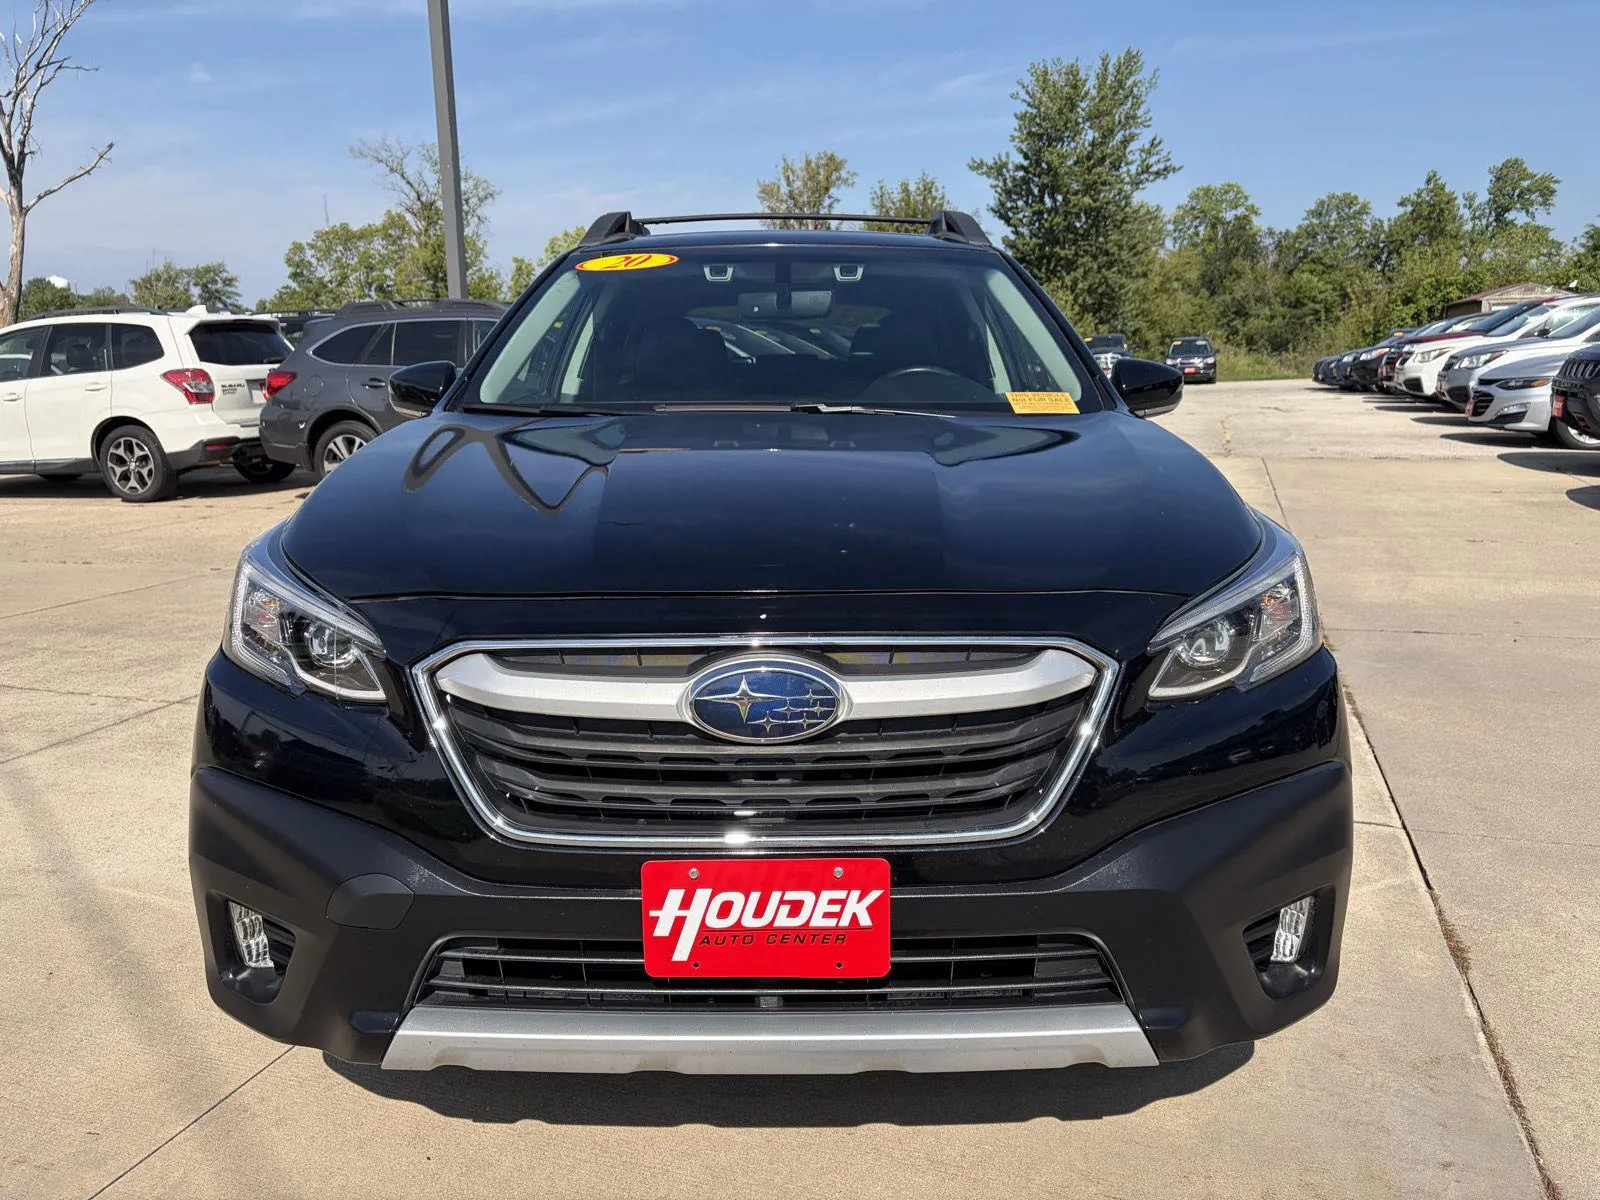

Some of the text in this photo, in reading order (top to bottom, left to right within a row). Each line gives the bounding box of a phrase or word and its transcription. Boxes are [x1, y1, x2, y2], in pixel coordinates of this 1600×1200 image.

[600, 254, 653, 269] 20
[649, 888, 885, 962] HOUDEK
[700, 933, 848, 946] AUTO CENTER
